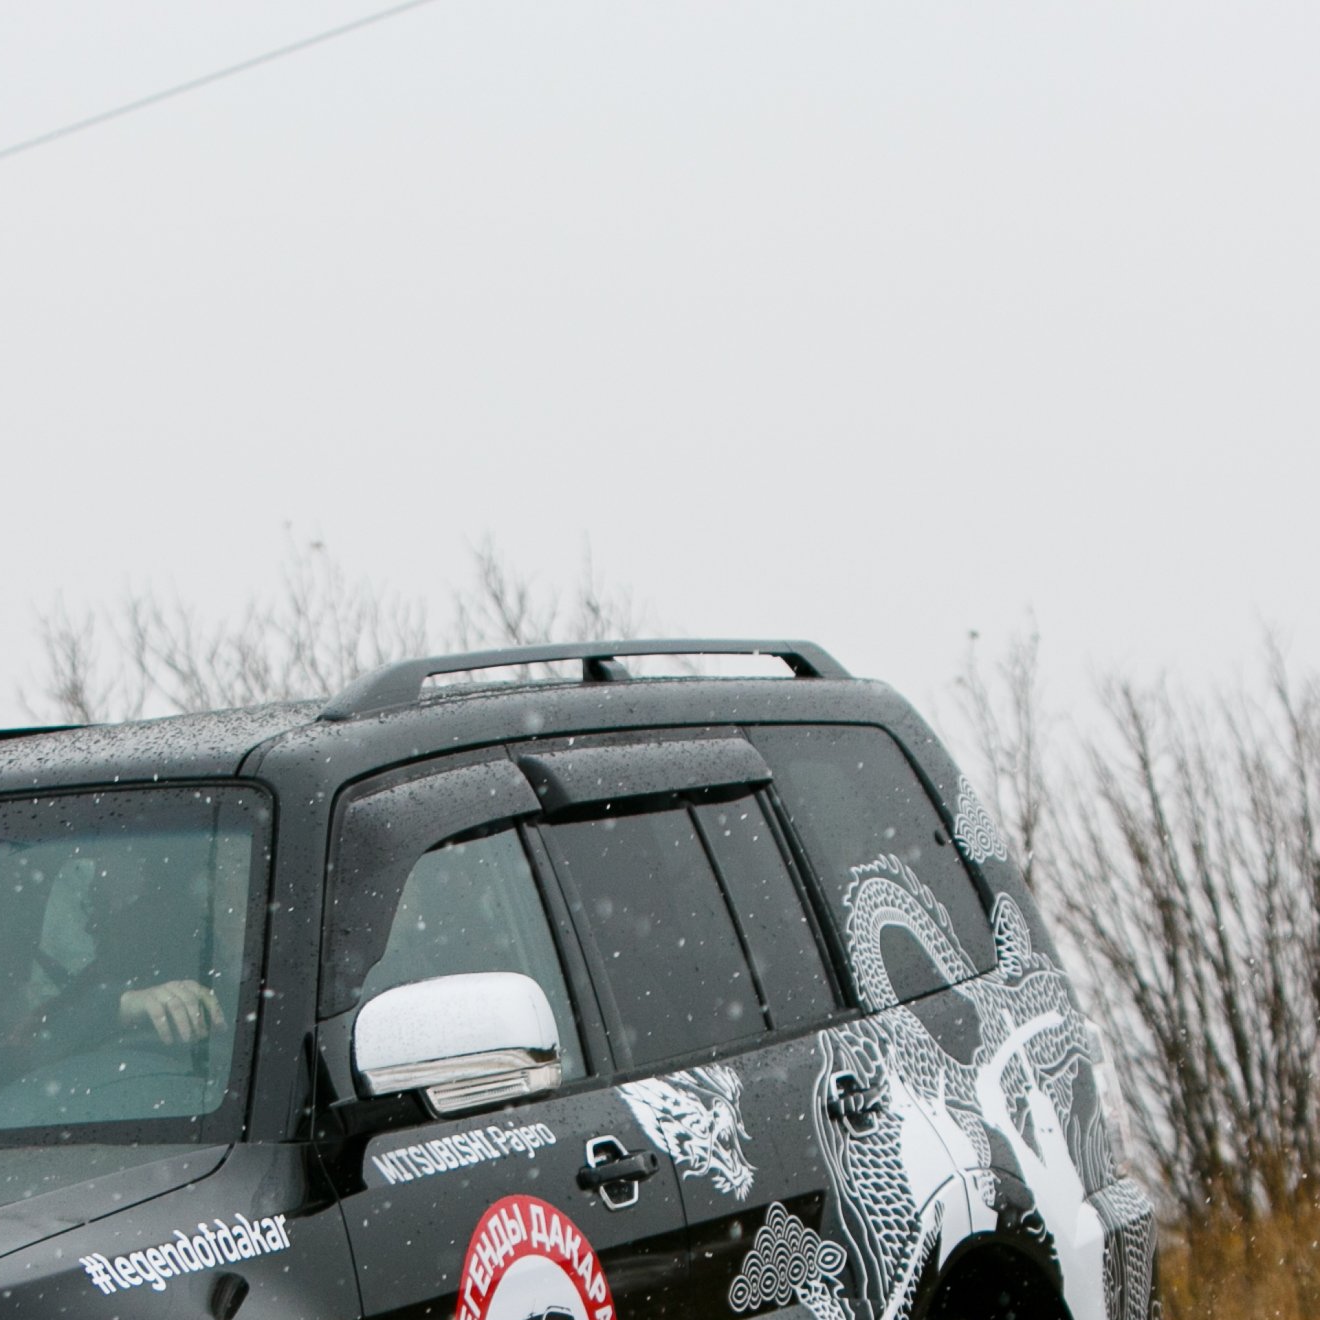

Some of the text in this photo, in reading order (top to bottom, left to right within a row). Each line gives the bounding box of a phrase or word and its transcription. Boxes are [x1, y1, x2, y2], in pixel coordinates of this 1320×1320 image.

[372, 1121, 556, 1184] MITSUBISHI Pajero
[79, 1212, 291, 1295] #legendofdakar
